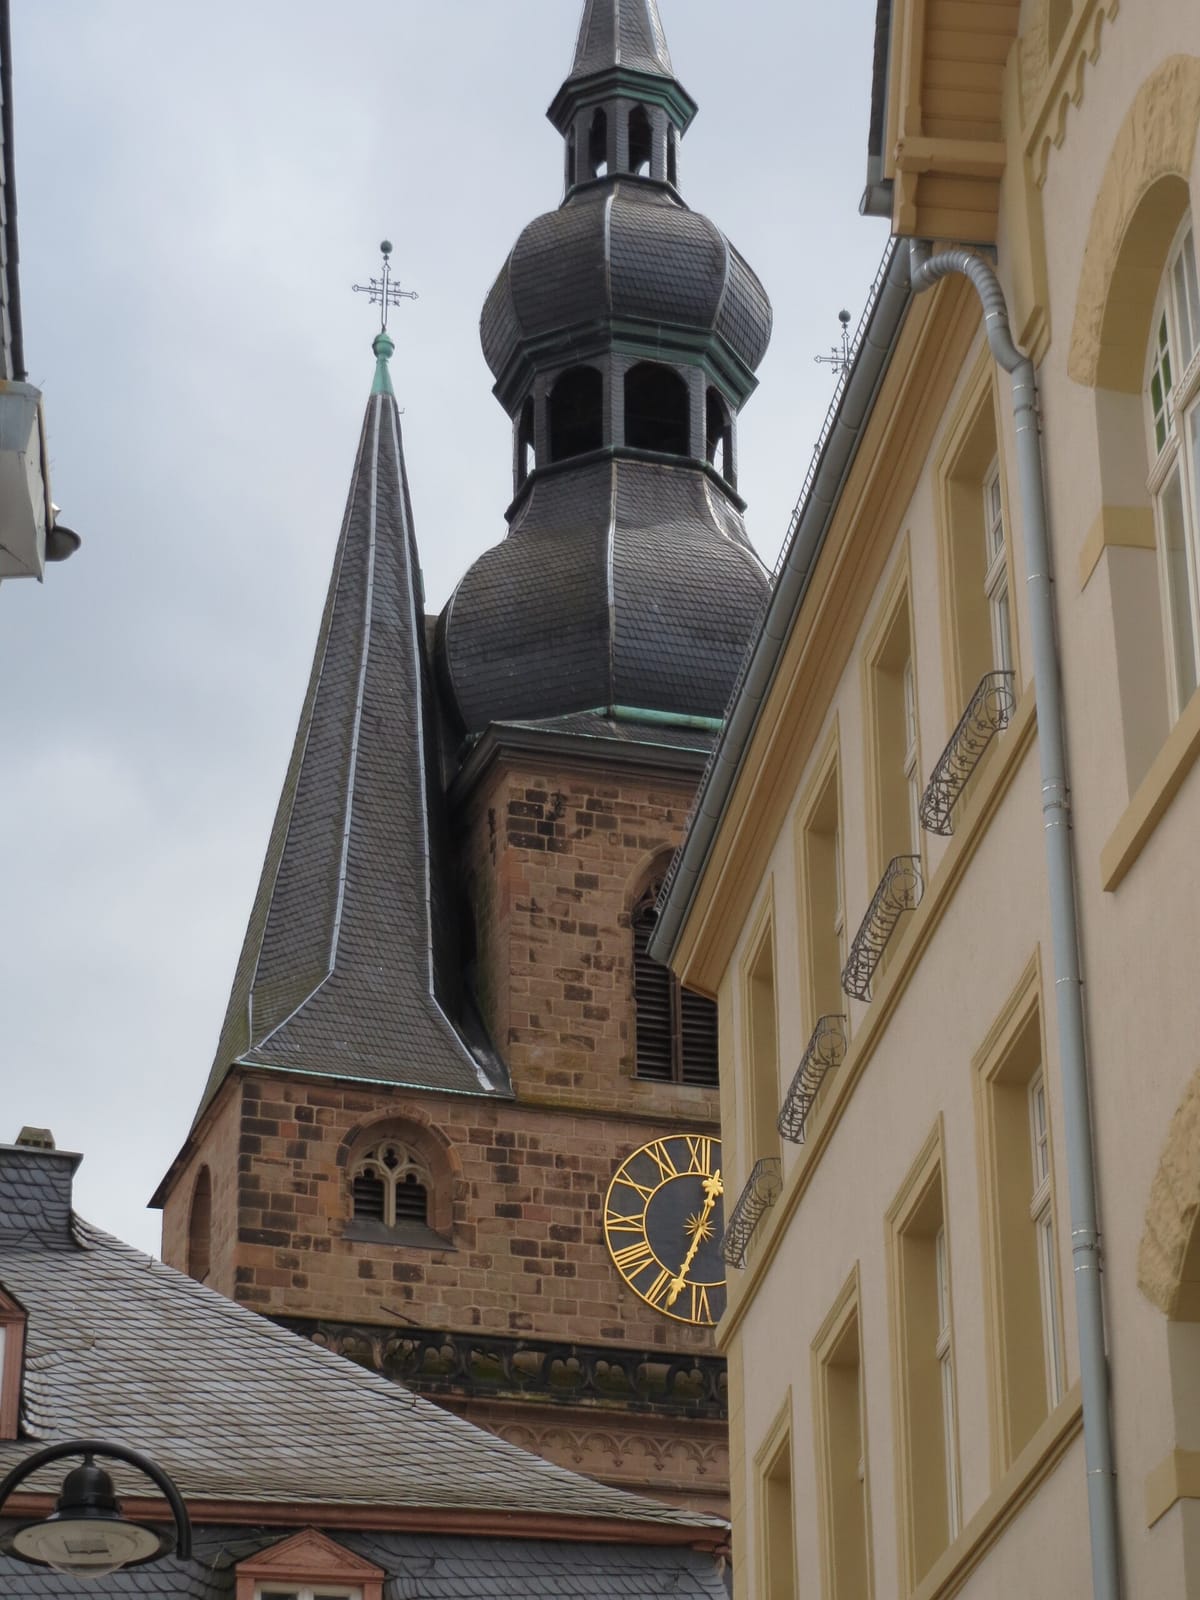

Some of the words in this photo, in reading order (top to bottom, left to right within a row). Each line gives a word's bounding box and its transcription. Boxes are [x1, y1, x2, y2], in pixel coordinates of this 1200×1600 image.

[644, 1141, 678, 1181] XI
[685, 1136, 711, 1174] XII
[615, 1168, 654, 1201] X
[606, 1208, 645, 1232] IX
